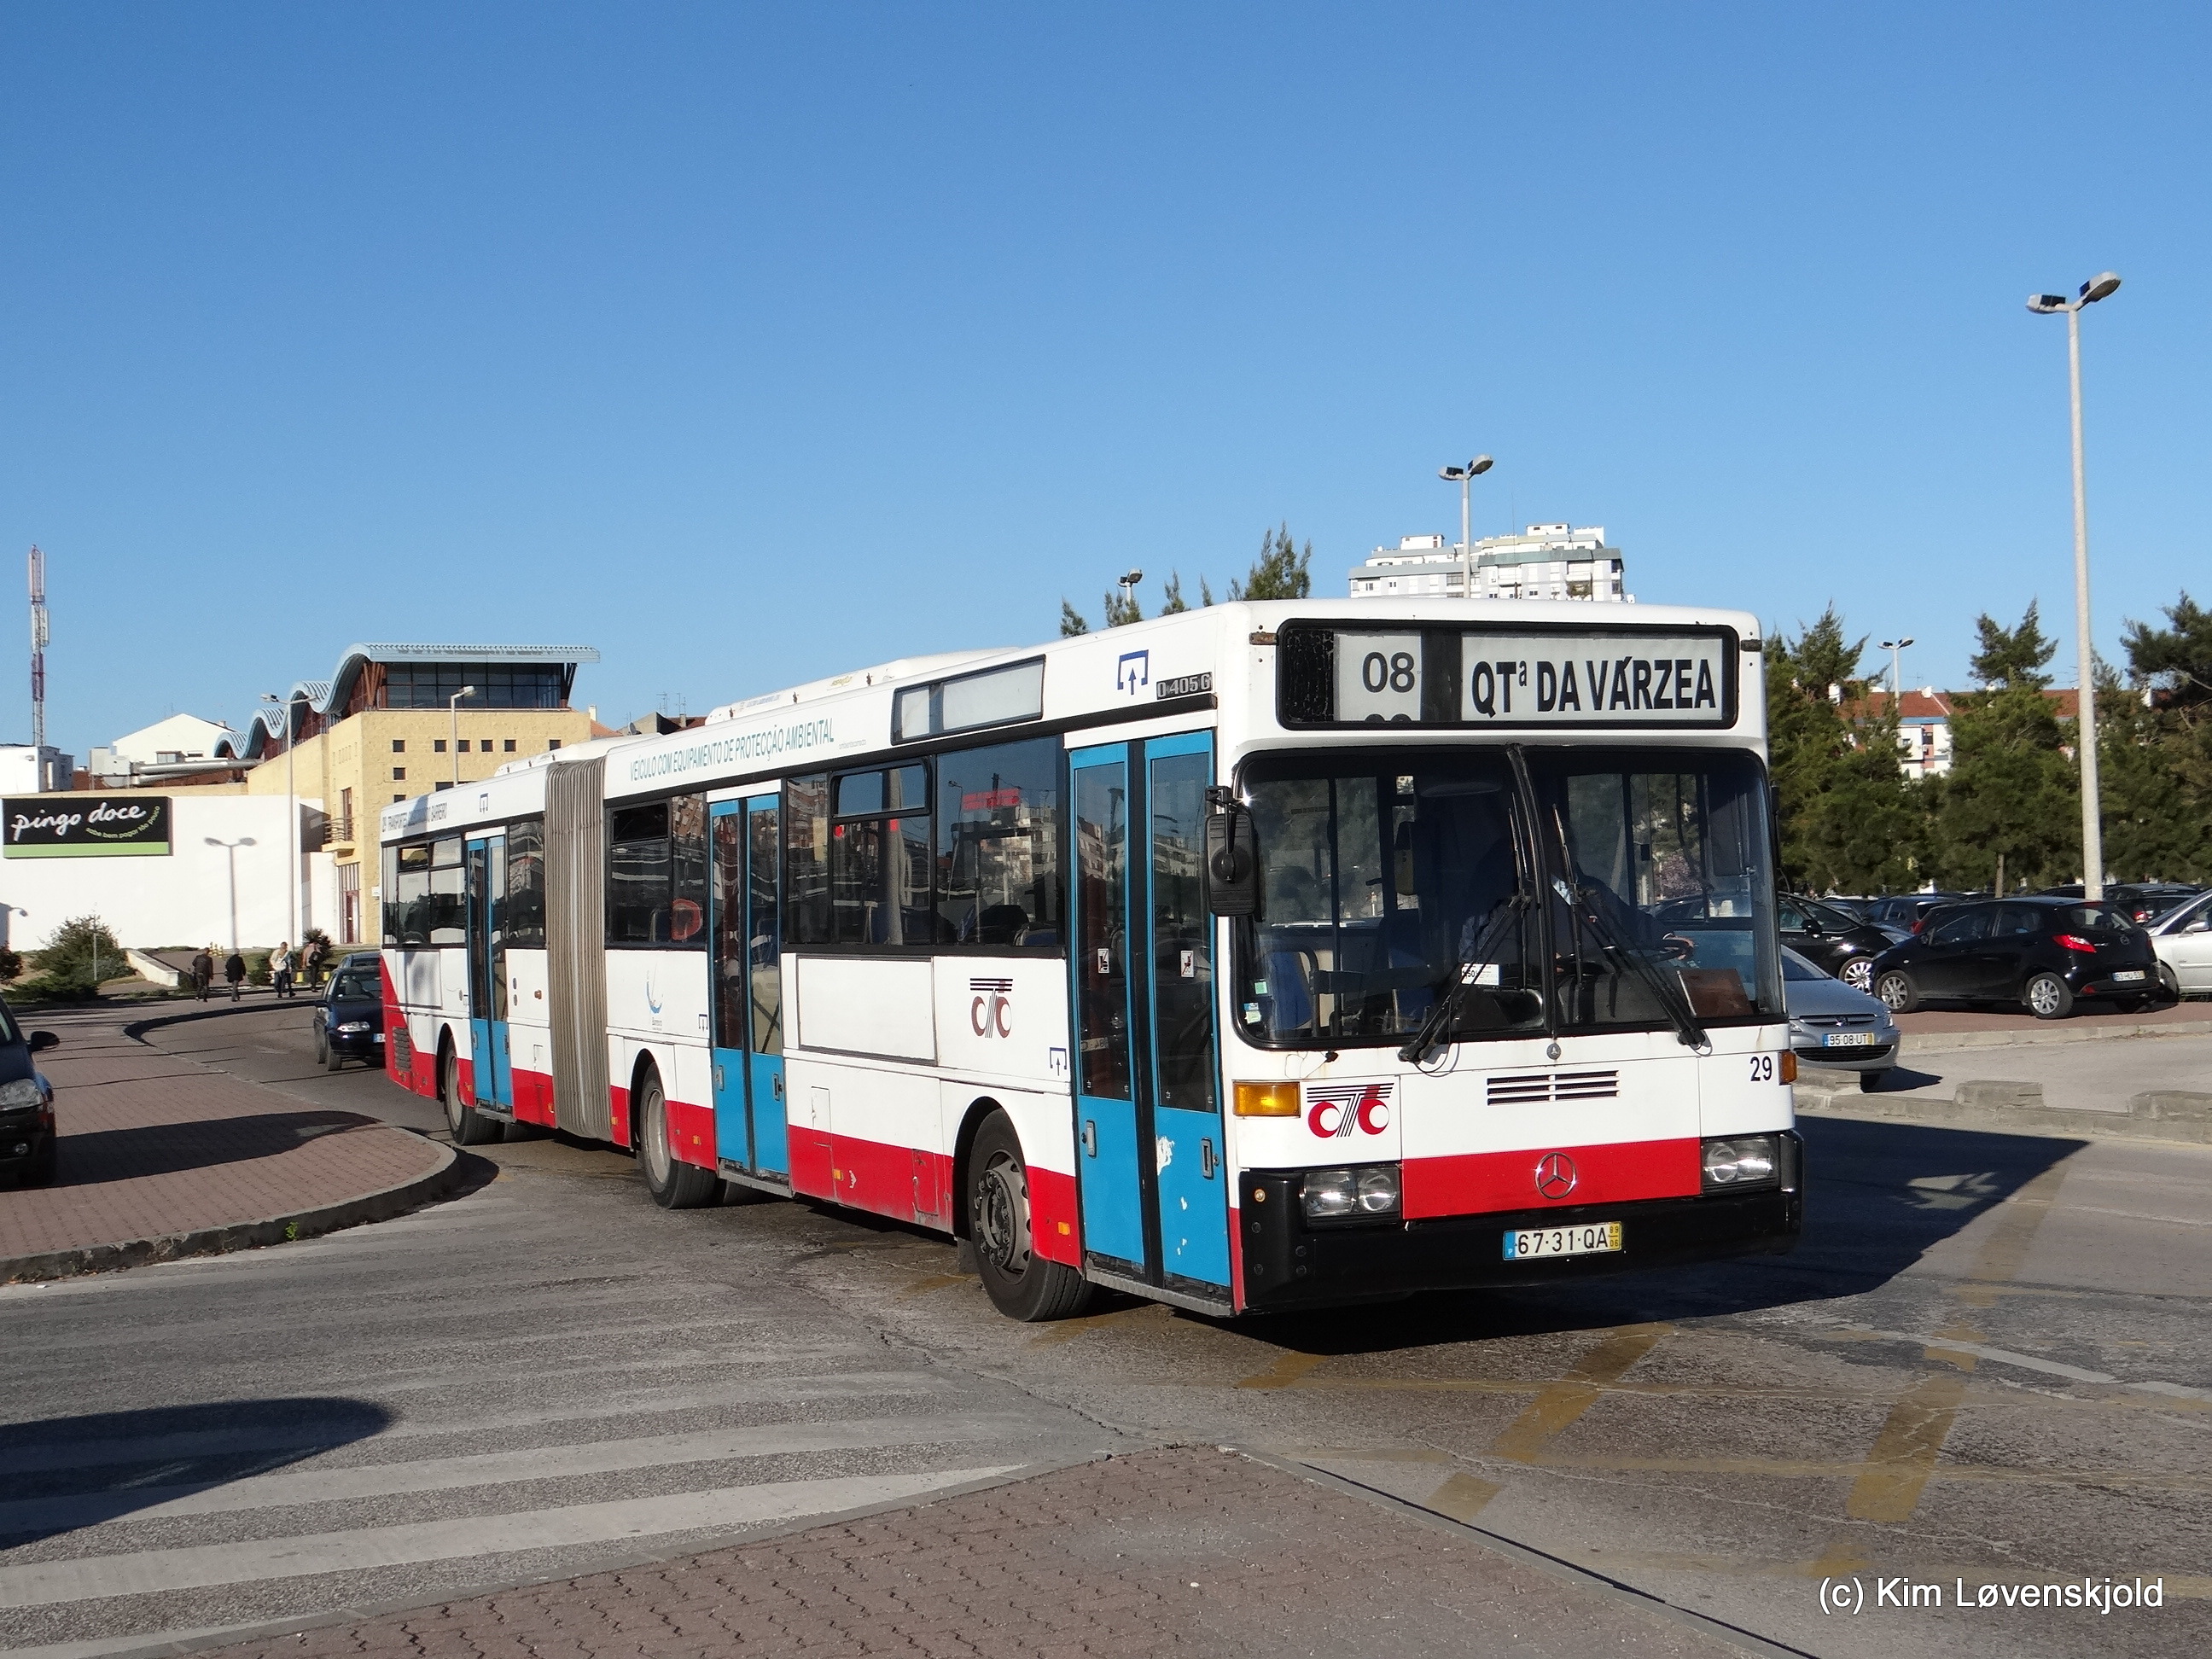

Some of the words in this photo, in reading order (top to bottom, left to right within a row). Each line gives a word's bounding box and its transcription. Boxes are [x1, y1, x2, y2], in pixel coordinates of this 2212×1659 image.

[1362, 651, 1415, 693] 08
[1537, 660, 1581, 713] DA
[1586, 655, 1717, 713] VÁRZEA
[630, 754, 656, 782] VEÍCULO
[658, 753, 672, 776] COM
[673, 741, 723, 773] EQUIPAMENTO
[724, 738, 734, 763] DE
[784, 718, 835, 752] AMBIENTAL
[11, 809, 82, 842] pingo
[88, 801, 147, 824] doce
[1749, 1056, 1773, 1082] 29
